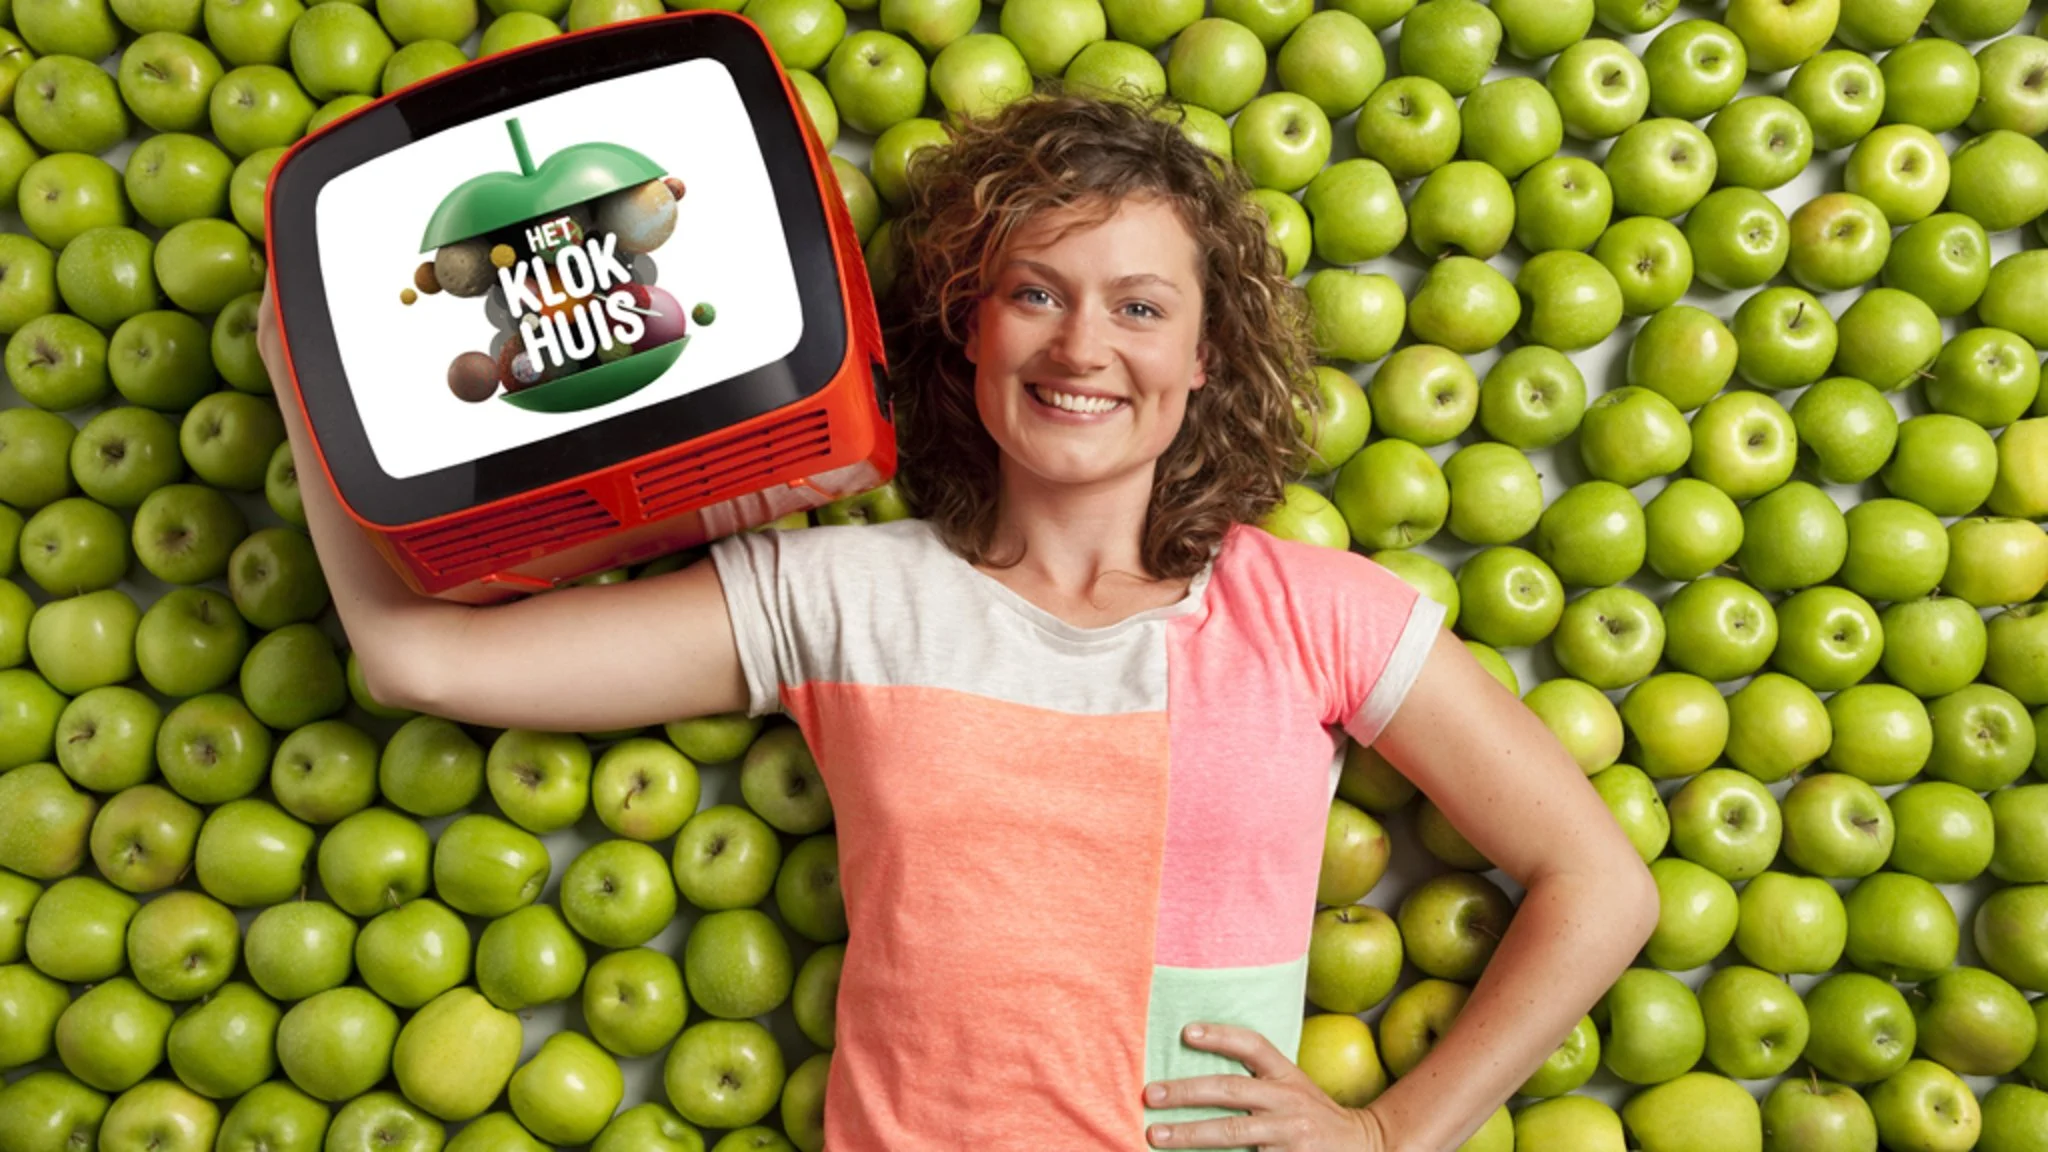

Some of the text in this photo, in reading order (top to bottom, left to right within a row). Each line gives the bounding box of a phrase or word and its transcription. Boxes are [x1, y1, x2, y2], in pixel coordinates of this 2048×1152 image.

[498, 232, 632, 318] KLOK
[525, 216, 571, 252] HET
[520, 290, 645, 373] HUIS
